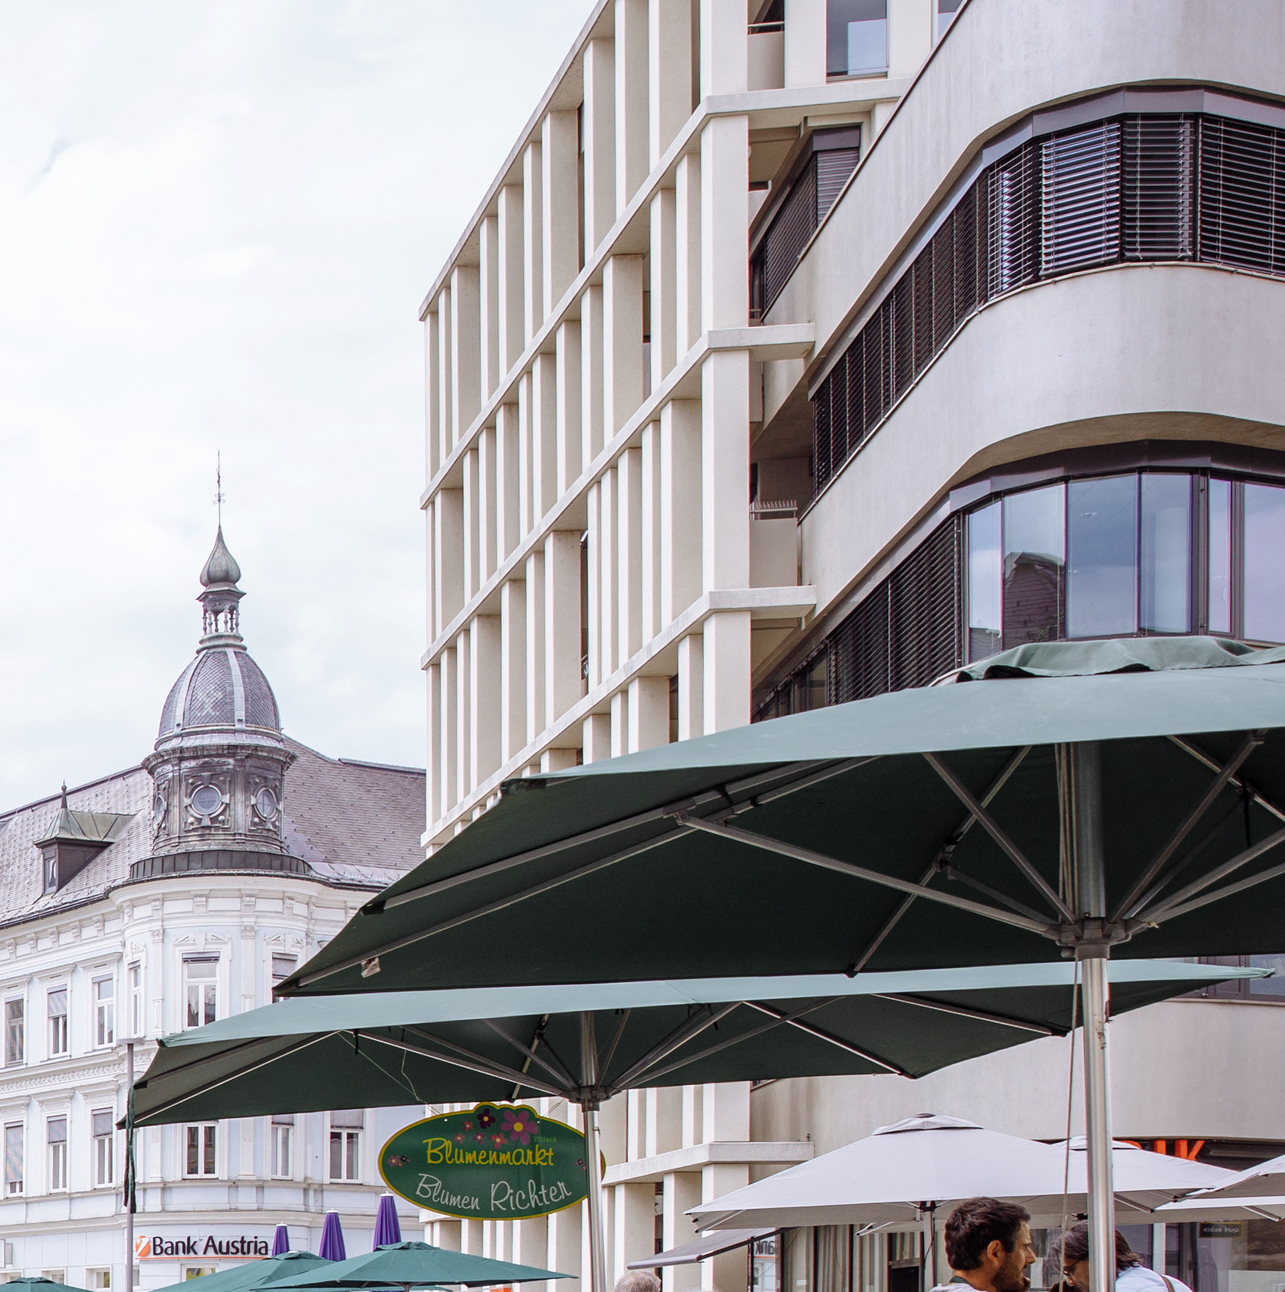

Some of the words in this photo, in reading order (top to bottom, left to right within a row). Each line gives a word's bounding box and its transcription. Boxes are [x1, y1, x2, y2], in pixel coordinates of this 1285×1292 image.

[422, 1137, 555, 1167] Blumenmarkt
[415, 1173, 481, 1210] Blumen
[490, 1179, 572, 1212] Richter
[152, 1235, 198, 1256] Bank
[202, 1235, 269, 1256] Austria
